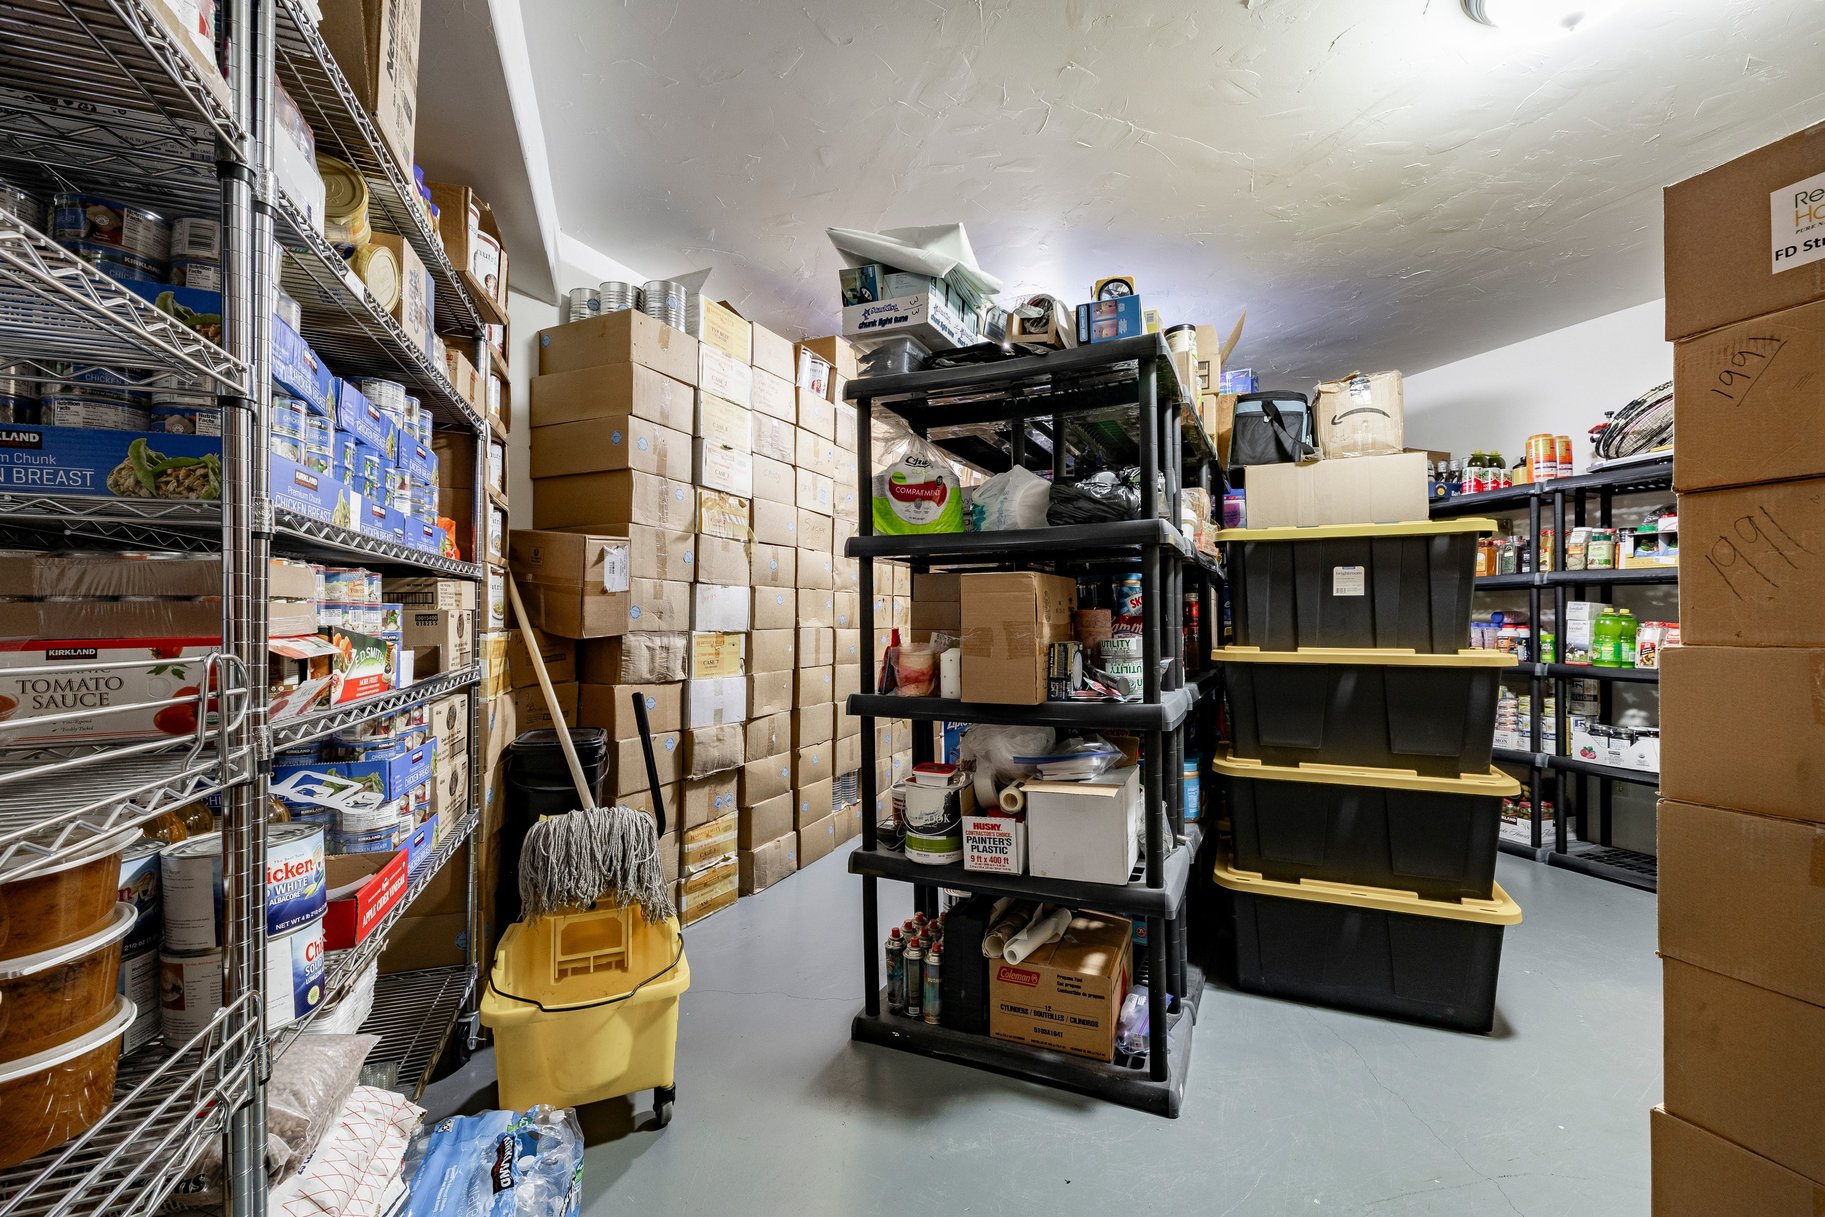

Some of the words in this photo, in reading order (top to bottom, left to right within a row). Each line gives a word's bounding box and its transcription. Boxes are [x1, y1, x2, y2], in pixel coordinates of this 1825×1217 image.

[1775, 245, 1797, 261] FD
[858, 319, 877, 330] chunk
[879, 316, 894, 328] light
[893, 314, 909, 324] tuna
[85, 373, 122, 385] CHICKEN
[0, 430, 40, 443] LAND
[14, 452, 57, 465] Chunk
[13, 468, 95, 487] BREAST
[287, 485, 308, 500] Premium
[308, 493, 322, 505] Chunk
[275, 494, 307, 515] CHICKEN
[307, 506, 331, 523] BREAST
[1101, 639, 1130, 648] UTILITY
[48, 648, 96, 656] KIRKLAND
[16, 676, 125, 694] TOMATO
[32, 692, 111, 710] SAUCE
[973, 822, 1002, 831] HUSKY
[966, 836, 1012, 846] PAINTER'S
[971, 844, 1008, 855] PLASTIC
[970, 855, 975, 863] 9
[976, 855, 983, 863] ft
[988, 856, 1002, 864] 400
[1004, 857, 1010, 865] ft
[267, 859, 313, 885] icken
[275, 876, 309, 896] WHITE
[269, 891, 301, 906] ALBACORE
[362, 902, 377, 929] APPLE
[376, 889, 390, 913] CIDER
[389, 873, 406, 898] VINEGAR
[275, 920, 290, 930] NET
[290, 916, 301, 925] WT
[1000, 967, 1031, 983] Coleman
[1057, 974, 1073, 982] Propane
[1057, 988, 1081, 996] Combustible
[1000, 1003, 1029, 1015] CYLINDERS
[1033, 1010, 1065, 1022] BOUTEILLES
[1069, 1016, 1099, 1028] CILINDROS
[499, 1136, 515, 1188] KIRKLAND
